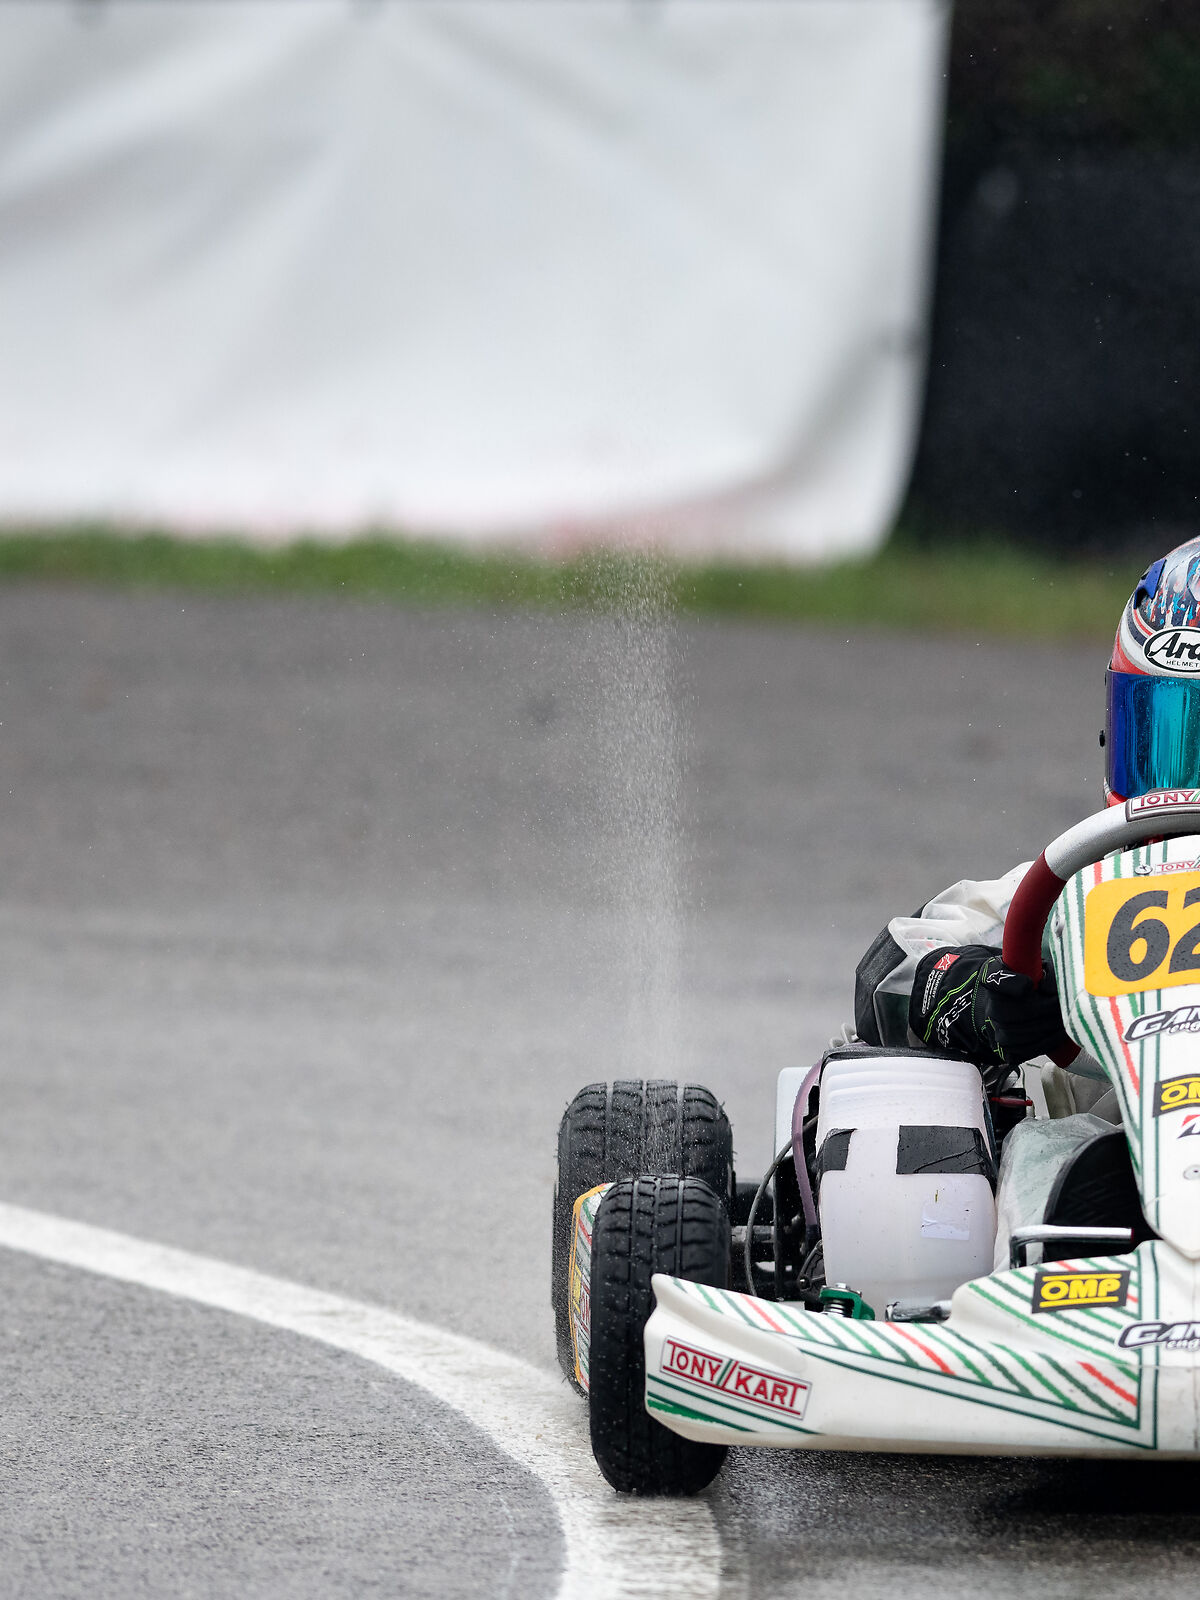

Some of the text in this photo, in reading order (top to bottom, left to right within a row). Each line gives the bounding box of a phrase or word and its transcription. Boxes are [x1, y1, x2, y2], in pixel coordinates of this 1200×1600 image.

[1138, 790, 1193, 806] TONY
[1158, 861, 1195, 871] TONY
[1041, 1278, 1120, 1301] OMP
[667, 1340, 807, 1407] TONY KART
